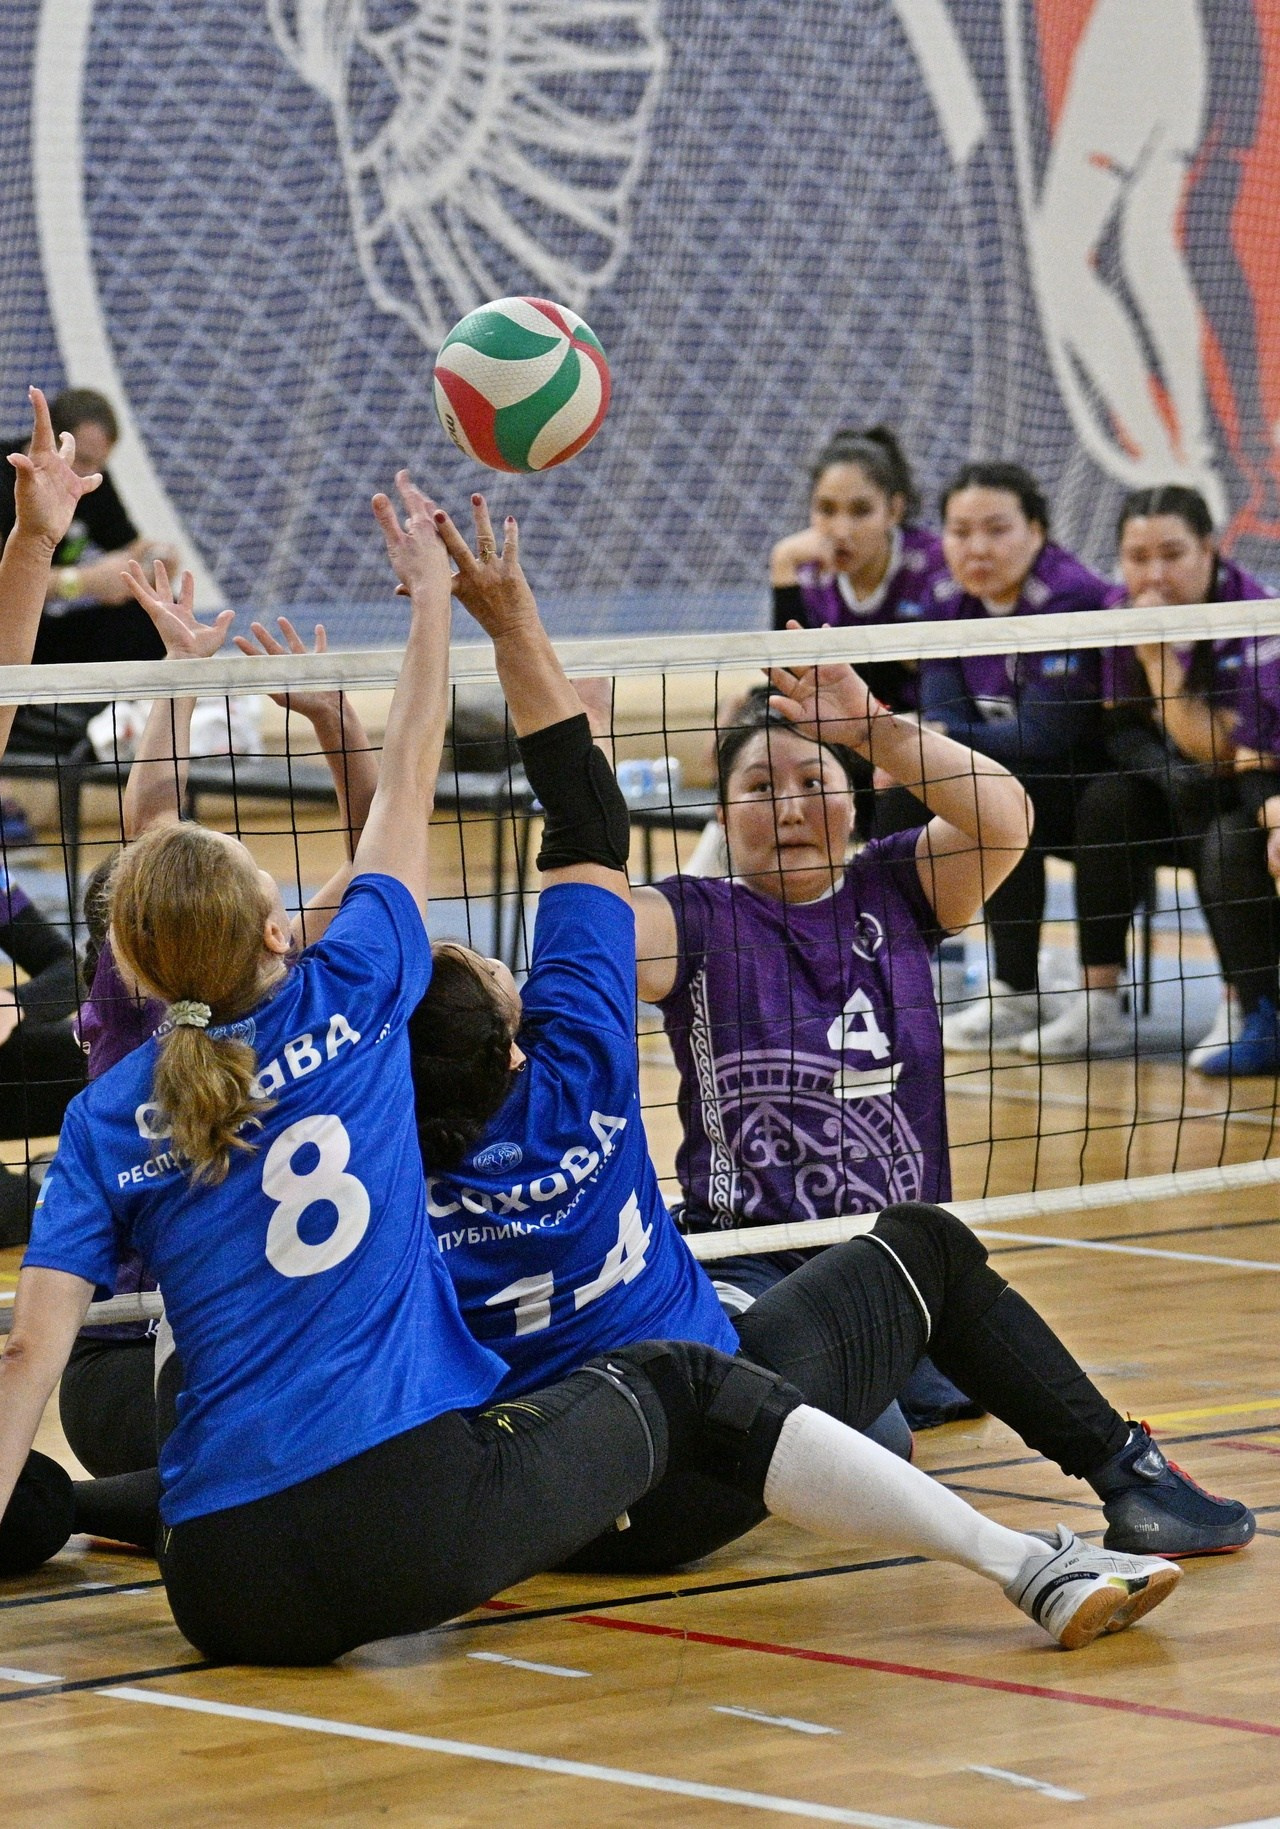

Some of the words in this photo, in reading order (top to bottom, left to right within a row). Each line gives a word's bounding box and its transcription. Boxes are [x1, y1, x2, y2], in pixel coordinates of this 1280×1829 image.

[826, 987, 892, 1061] 4
[261, 1114, 371, 1278] 8
[485, 1187, 653, 1337] 14
